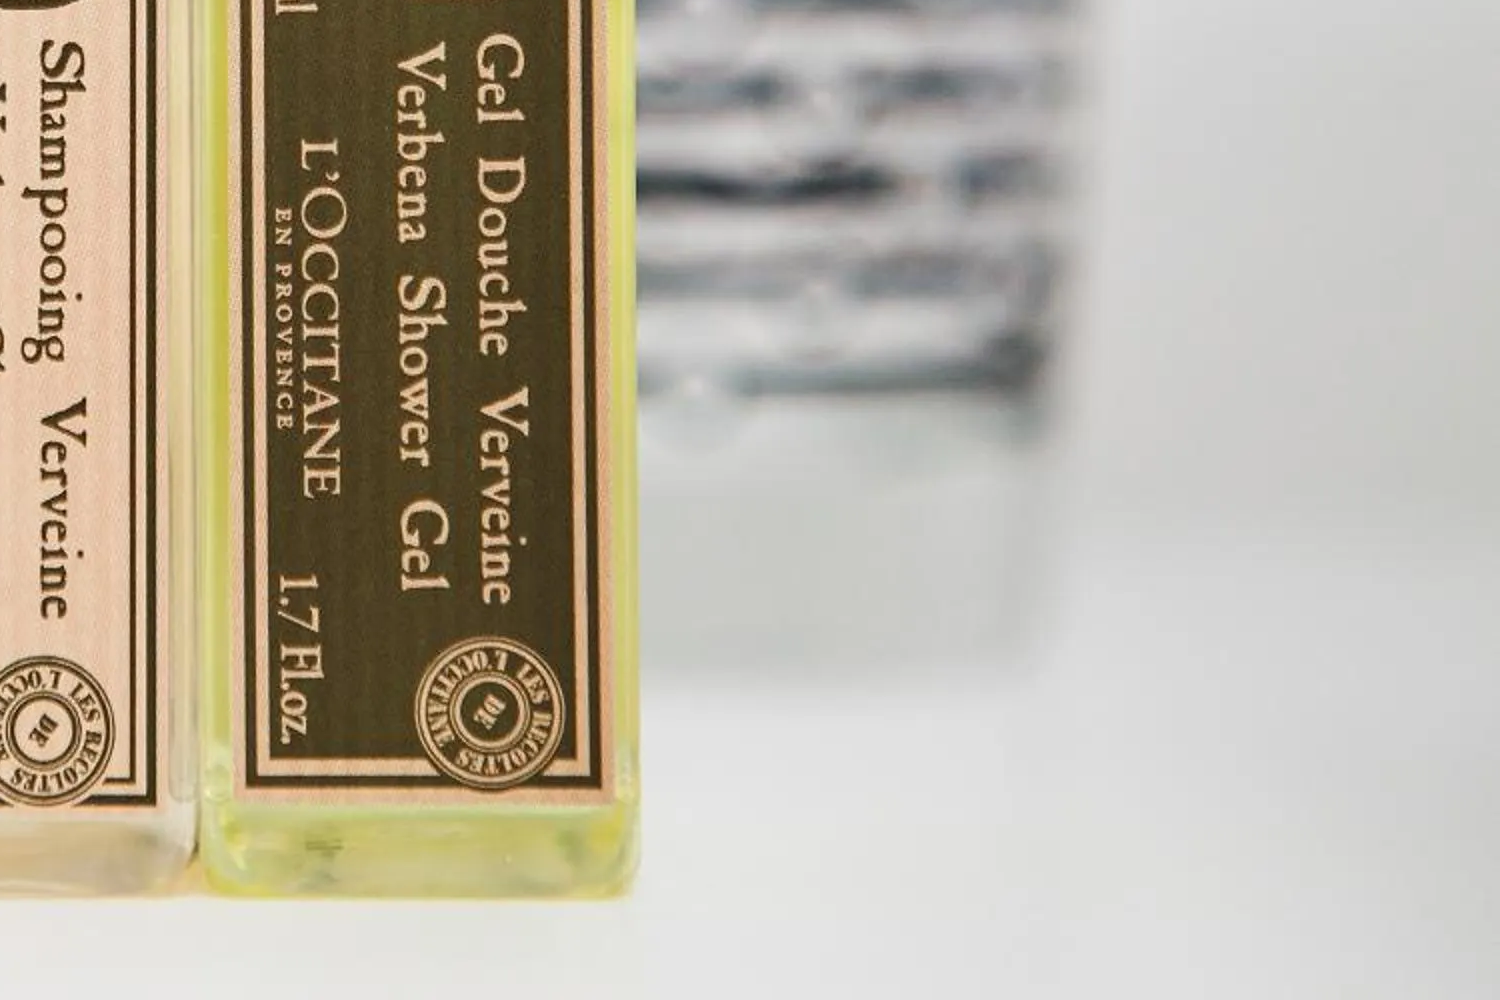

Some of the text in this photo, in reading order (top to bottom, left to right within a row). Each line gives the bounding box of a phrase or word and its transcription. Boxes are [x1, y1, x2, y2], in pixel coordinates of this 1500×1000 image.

[20, 39, 88, 621] Shampooing Verveine
[274, 206, 295, 430] EN PROVENCE
[300, 138, 348, 500] L'OCCITANE
[397, 40, 451, 592] Verbena Shower Gel
[476, 33, 530, 605] Gel Douche Verveine
[68, 682, 101, 723] LES
[277, 573, 320, 633] 1.7
[516, 663, 550, 705] LES
[28, 713, 59, 748] DE
